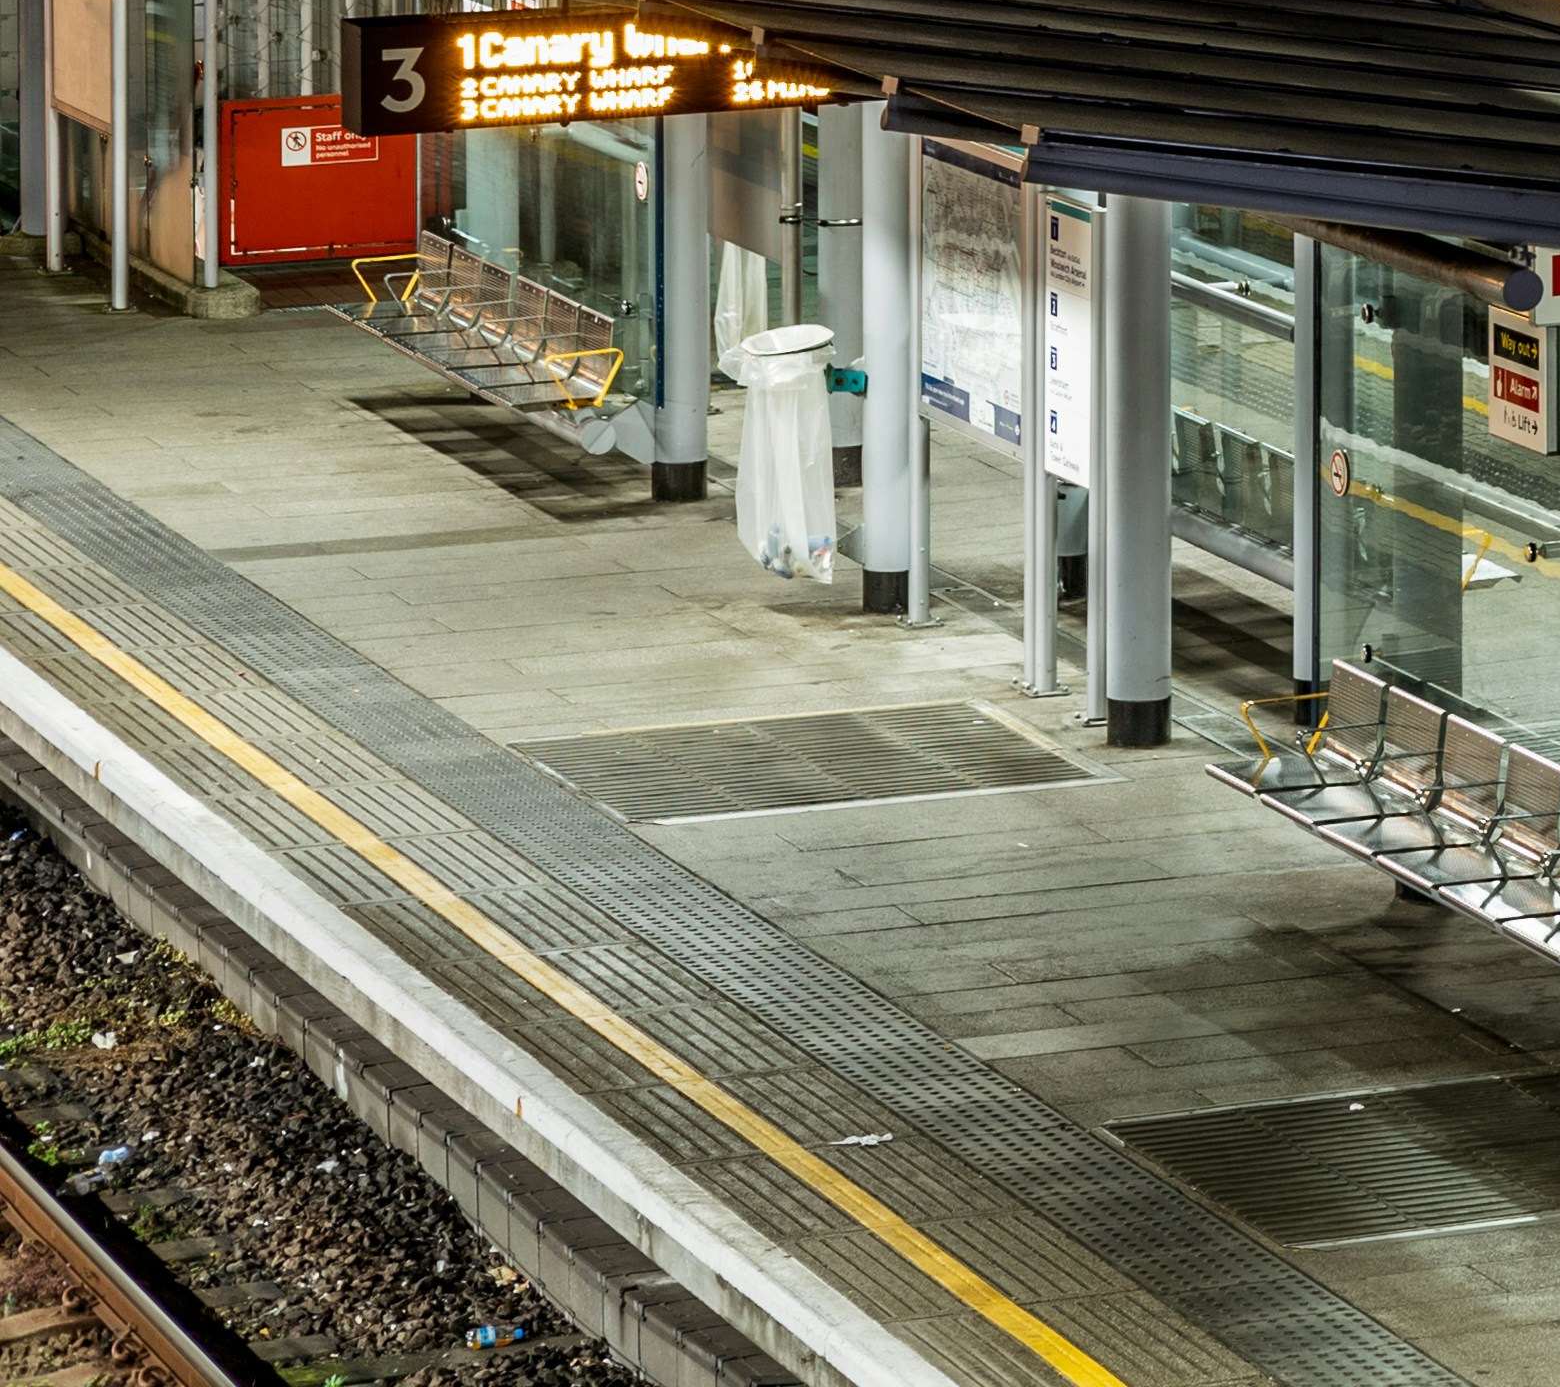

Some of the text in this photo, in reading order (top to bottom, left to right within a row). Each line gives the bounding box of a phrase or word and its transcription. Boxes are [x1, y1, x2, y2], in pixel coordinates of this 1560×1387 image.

[457, 31, 614, 70] 1 Canary
[380, 47, 425, 113] 3
[461, 78, 478, 99] 2
[479, 72, 581, 97] CANARY
[590, 65, 674, 88] WHARF
[461, 100, 478, 120] 3
[479, 94, 581, 119] CANARY
[590, 87, 674, 112] WHARF
[316, 131, 342, 142] Staff
[327, 142, 371, 151] unauthorised
[316, 150, 349, 159] personnel
[1501, 331, 1531, 358] Way out
[1509, 377, 1532, 400] Alarm
[1517, 414, 1532, 434] Lift
